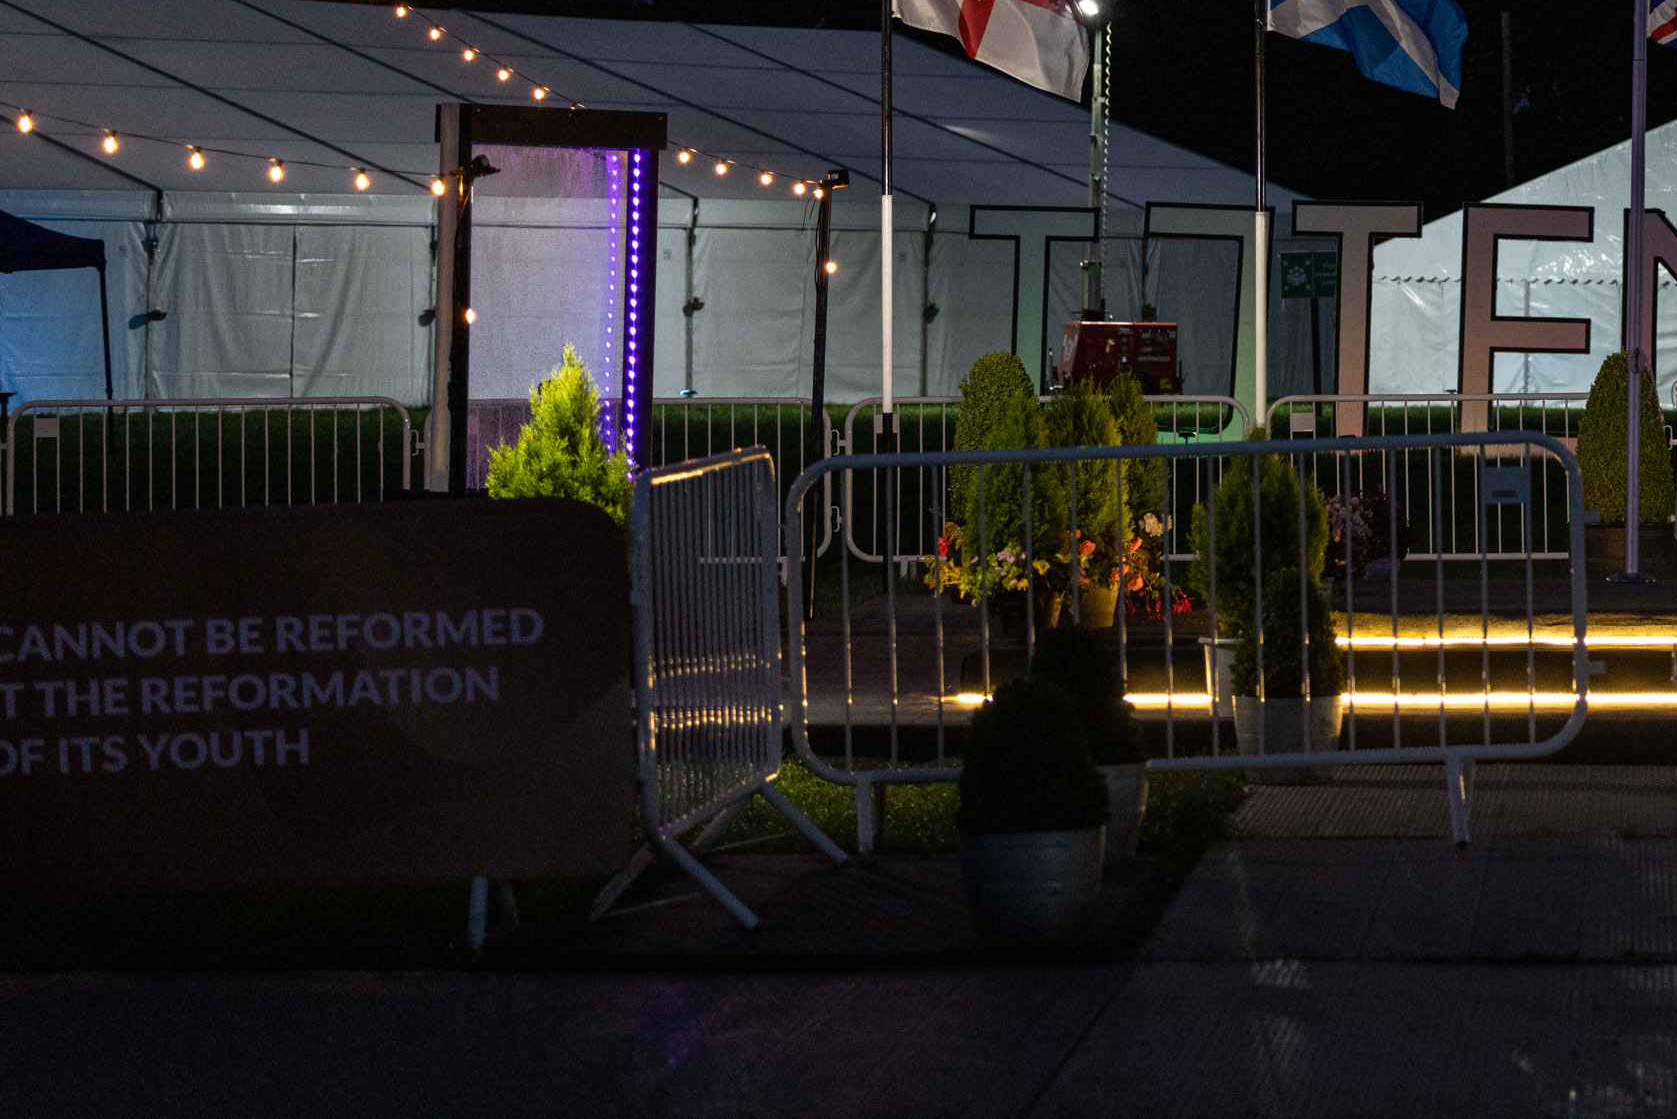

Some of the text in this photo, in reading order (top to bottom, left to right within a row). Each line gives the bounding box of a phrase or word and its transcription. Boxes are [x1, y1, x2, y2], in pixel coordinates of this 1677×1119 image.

[205, 617, 264, 655] BE
[275, 607, 545, 653] REFORMED
[34, 678, 129, 718] THE
[140, 665, 499, 715] REFORMATION
[57, 735, 128, 774] ITS
[136, 728, 310, 771] YOUTH
